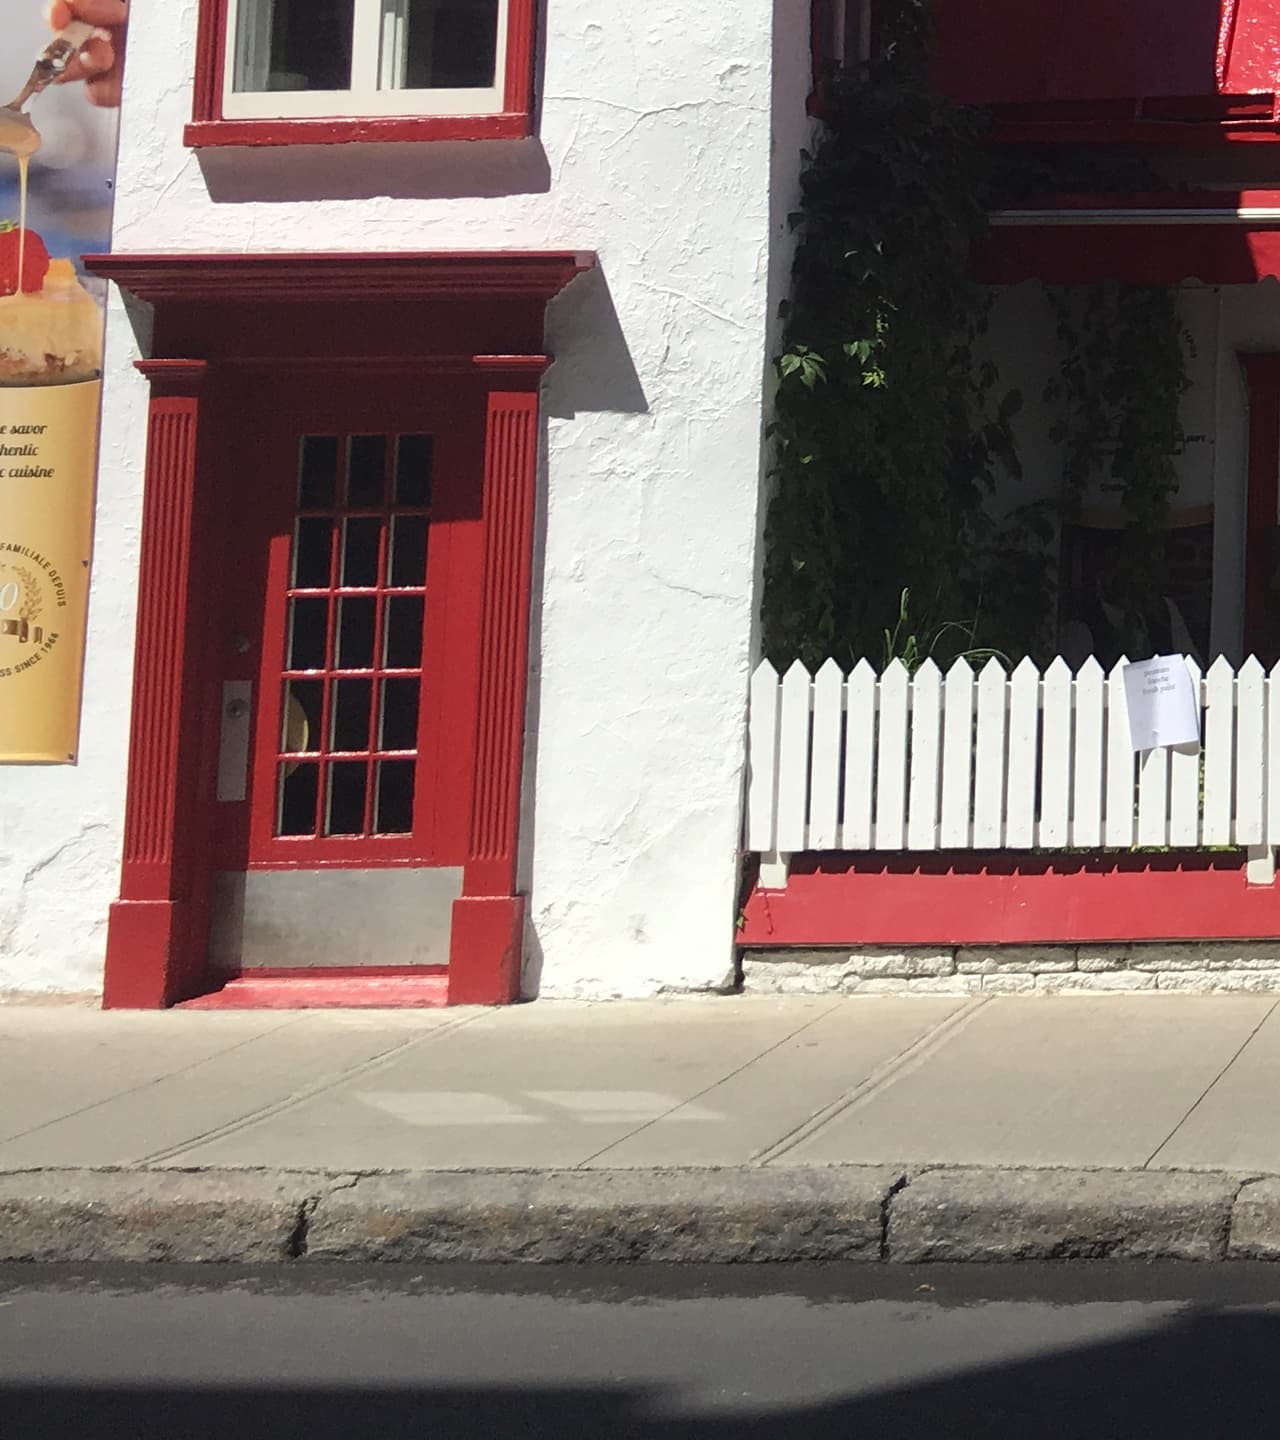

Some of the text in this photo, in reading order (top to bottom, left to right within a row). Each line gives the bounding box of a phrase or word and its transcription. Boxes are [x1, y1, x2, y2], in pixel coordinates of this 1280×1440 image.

[10, 423, 48, 435] savor
[8, 466, 56, 479] cuisine
[47, 569, 68, 607] DEPUIS
[14, 654, 43, 674] SINCE
[40, 631, 60, 655] 1966
